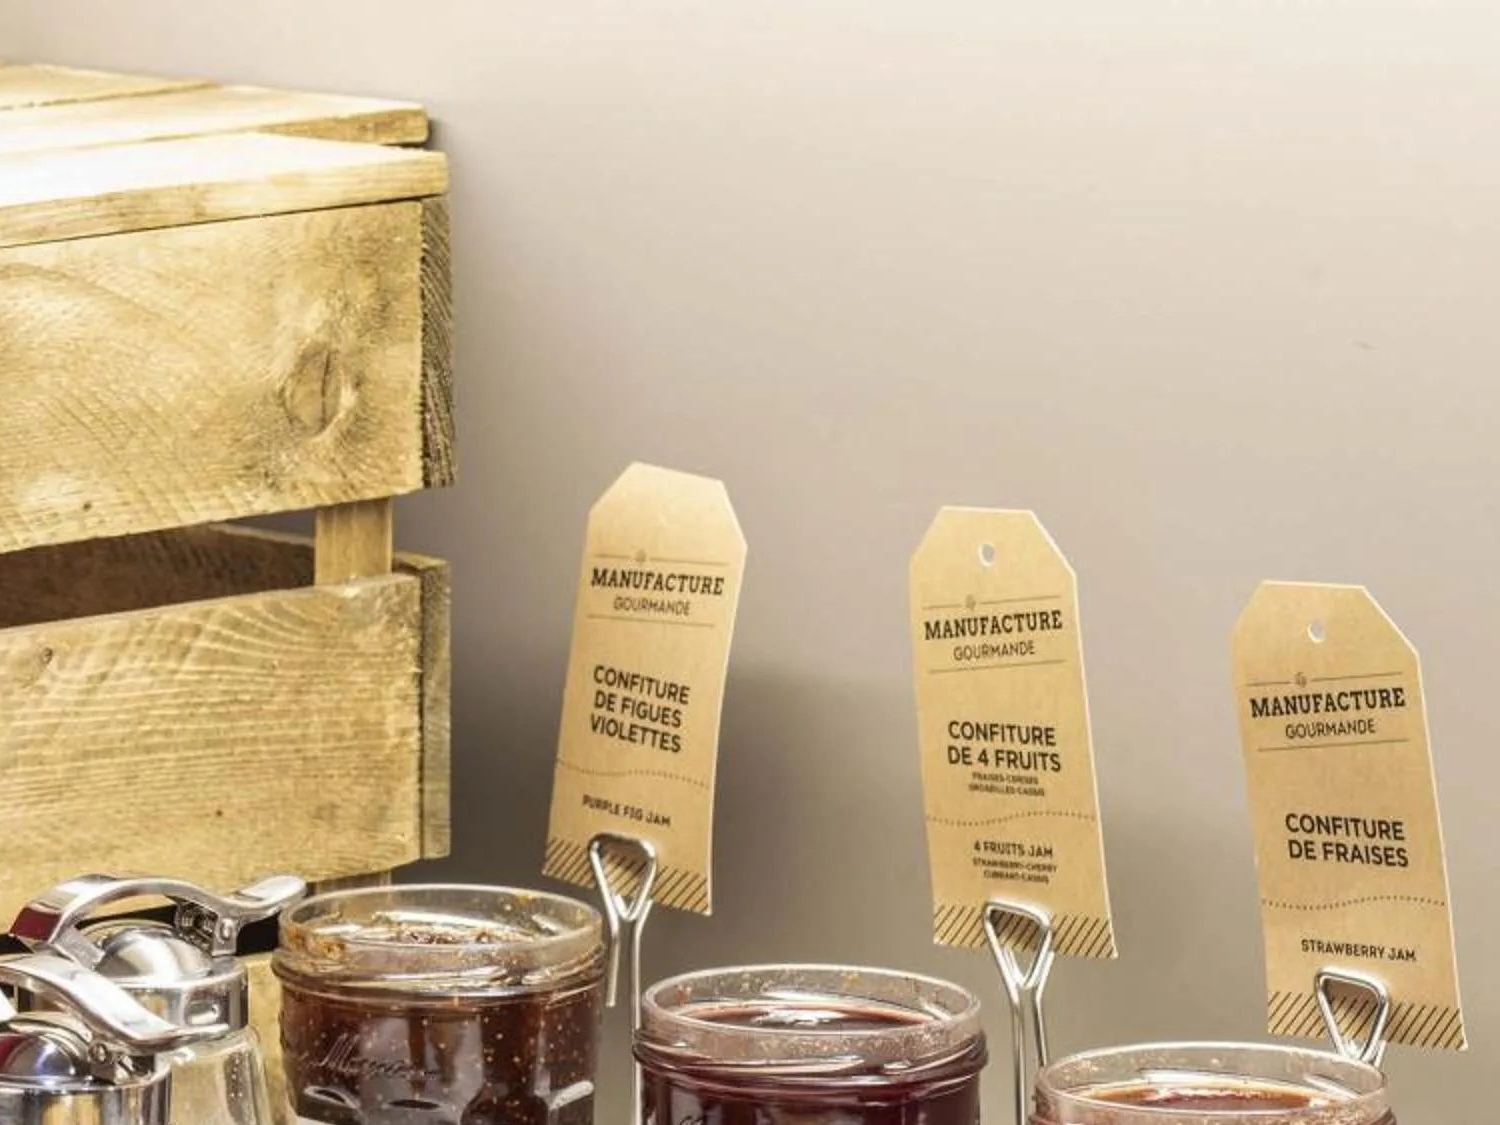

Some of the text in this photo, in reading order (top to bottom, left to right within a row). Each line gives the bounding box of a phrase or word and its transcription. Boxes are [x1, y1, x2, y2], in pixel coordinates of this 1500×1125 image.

[591, 567, 725, 596] MANUFACTURE
[613, 596, 691, 616] GOURMANDE
[924, 610, 1063, 641] MANUFACTURE
[953, 640, 1035, 661] GOURMANDE
[594, 665, 691, 704] CONFITURE
[594, 690, 682, 728] DE FIGUES
[1249, 687, 1405, 719] MANUFACTURE
[591, 713, 682, 753] VIOLETTES
[948, 720, 1056, 747] CONFITURE
[1285, 718, 1376, 740] GOURMANDE
[947, 745, 1061, 772] DE 4 FRUITS
[582, 794, 671, 827] PURPLE FIG JAM
[1285, 813, 1405, 841] CONFITURE
[974, 840, 1053, 859] 4 FRUITS JAM
[1287, 839, 1409, 868] DE FRAISES
[1300, 938, 1416, 962] STRAWBERRY JAM
